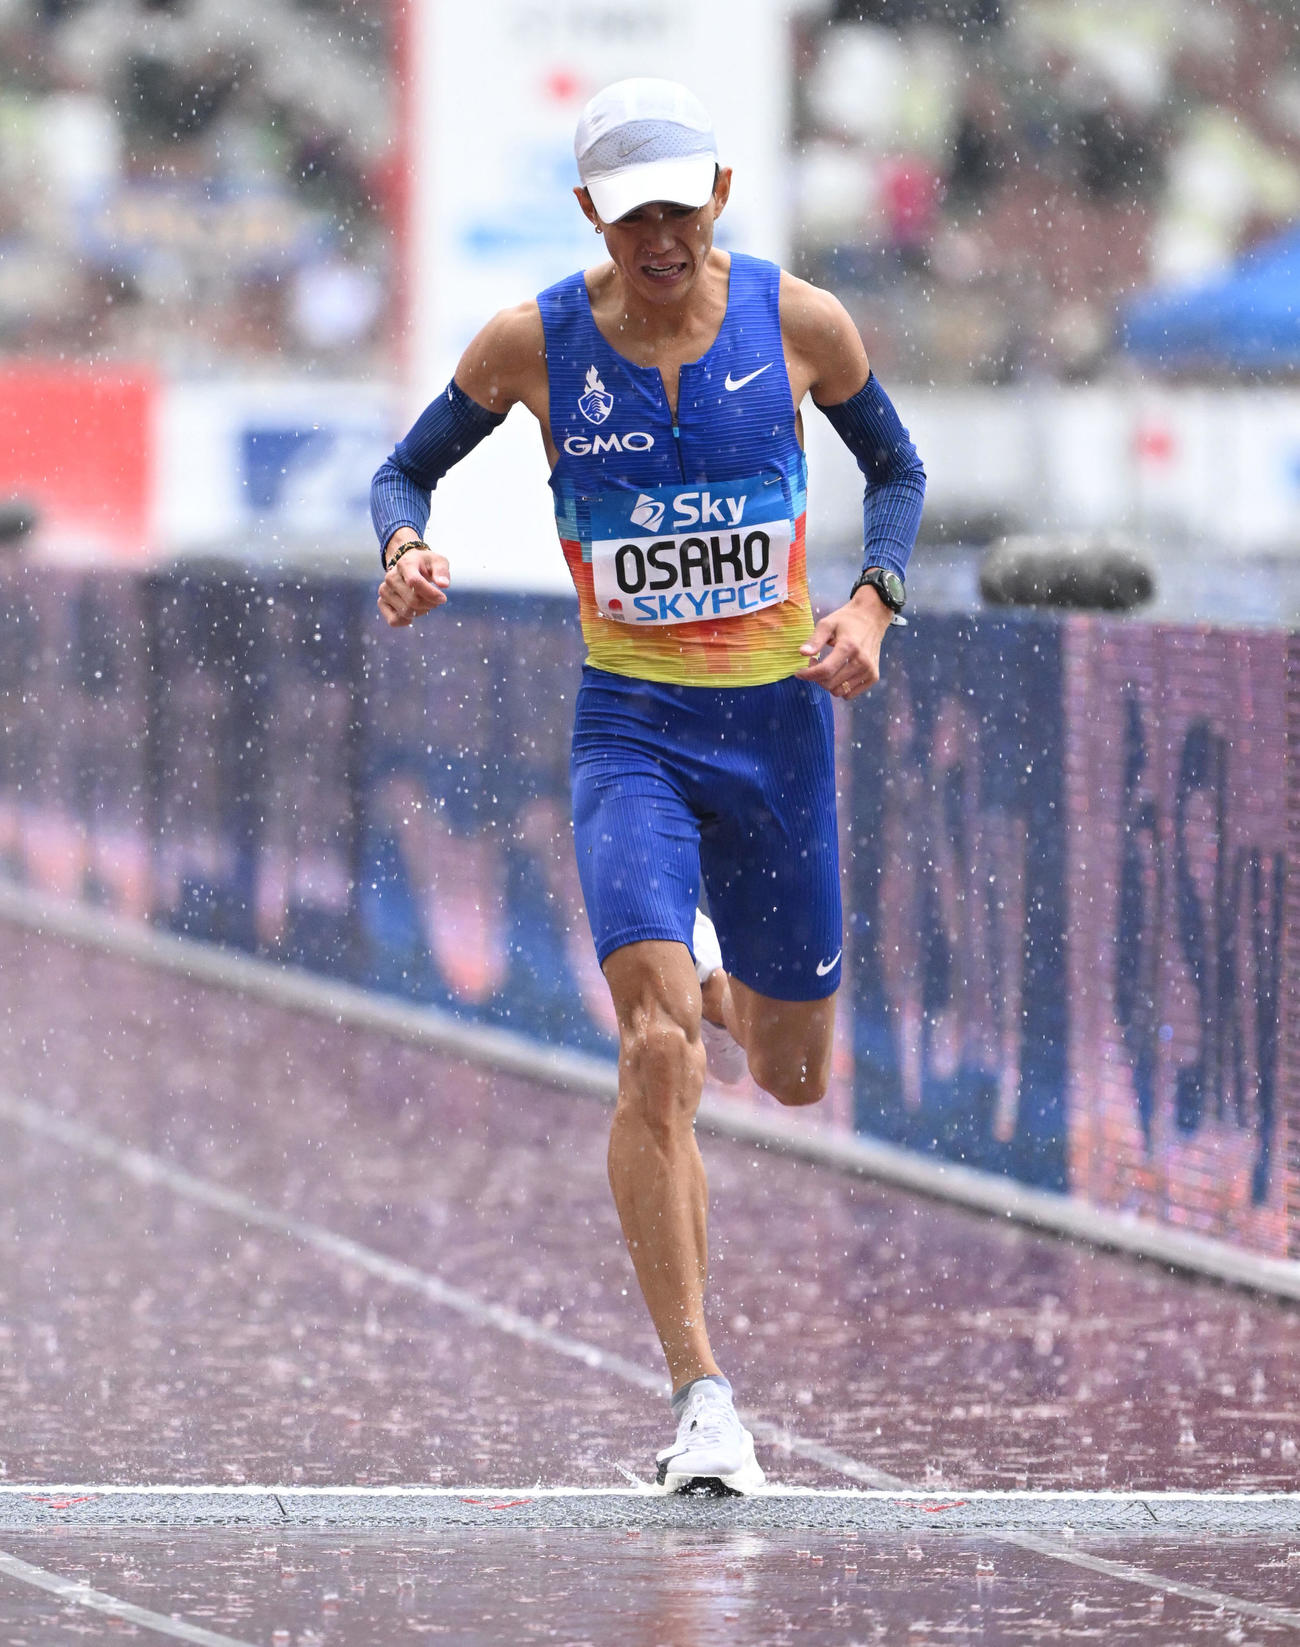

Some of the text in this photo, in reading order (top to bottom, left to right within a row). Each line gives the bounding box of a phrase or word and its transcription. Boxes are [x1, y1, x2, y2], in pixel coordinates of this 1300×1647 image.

[563, 431, 655, 456] GMO
[673, 491, 747, 527] Sky
[615, 530, 770, 595] OSAKO
[633, 574, 779, 621] SKYPCE
